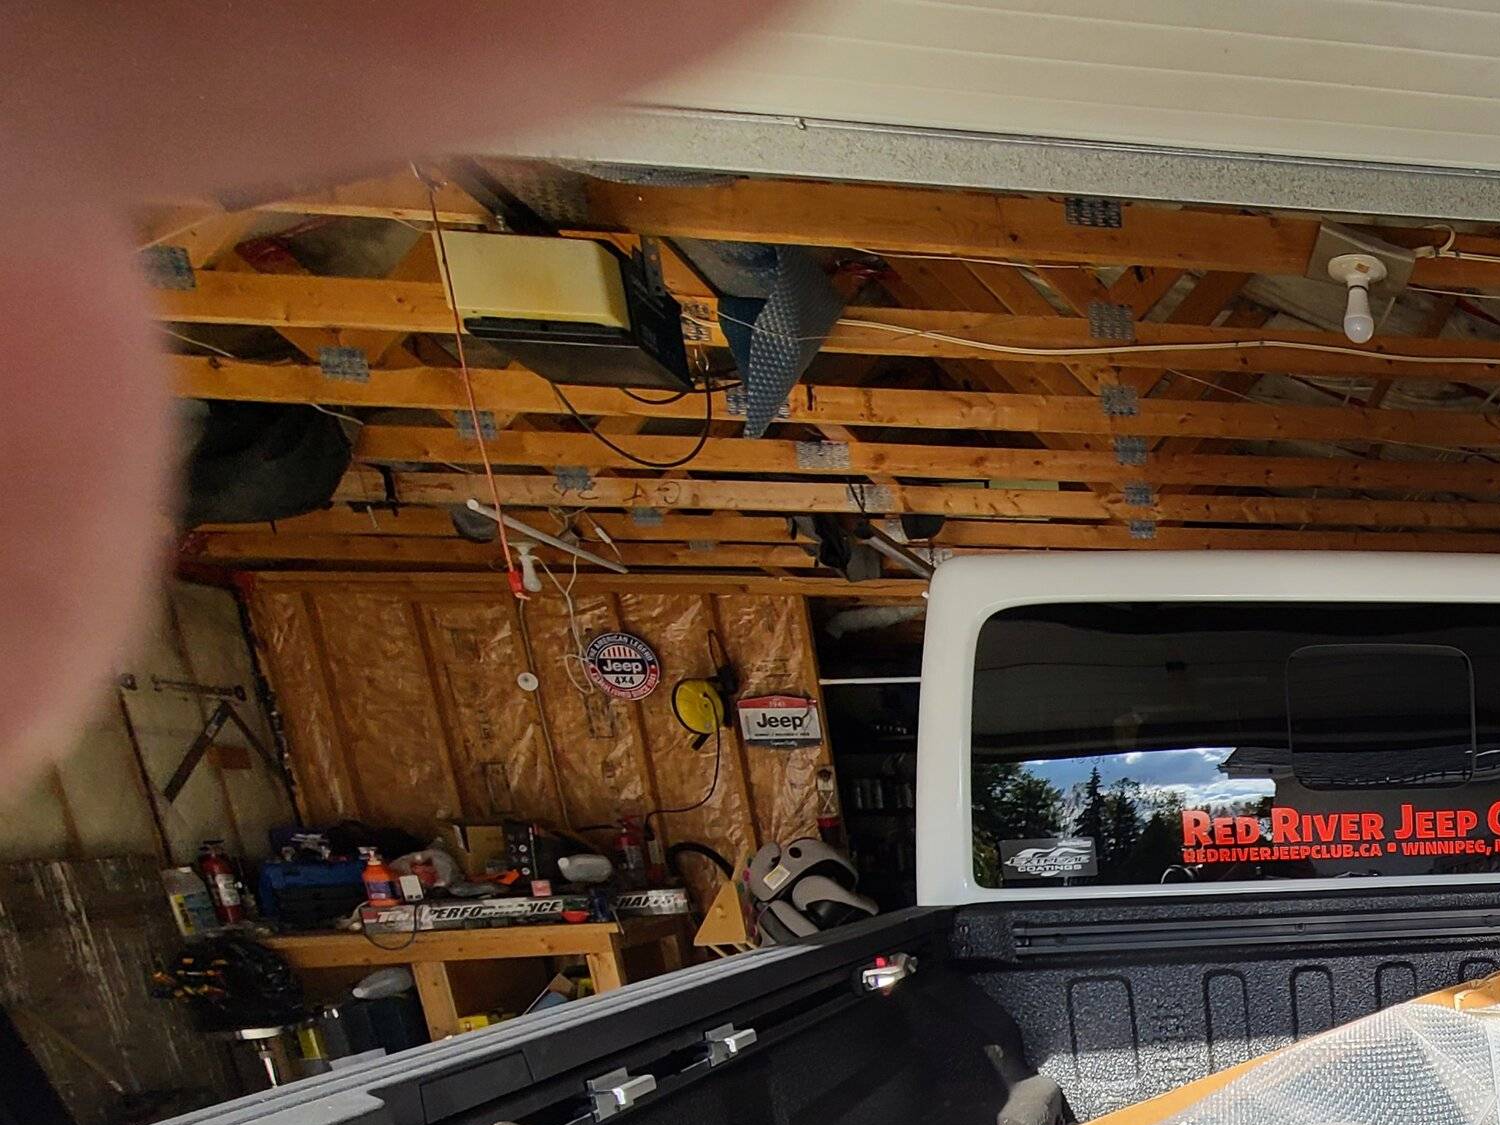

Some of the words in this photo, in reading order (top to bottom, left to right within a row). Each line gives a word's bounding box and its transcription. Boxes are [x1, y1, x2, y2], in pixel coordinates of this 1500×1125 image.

[630, 639, 654, 661] LEGEND
[602, 659, 642, 674] Jeep
[756, 712, 804, 731] Jeep
[1182, 810, 1260, 846] RED
[1271, 807, 1385, 843] RIVER
[1393, 804, 1478, 840] JEEP
[1183, 843, 1383, 863] REDRIVERJEEPCLUB.CA
[1402, 839, 1492, 856] WINNIPEG,
[1017, 864, 1083, 873] COATINGS
[429, 900, 562, 920] PERFONCE
